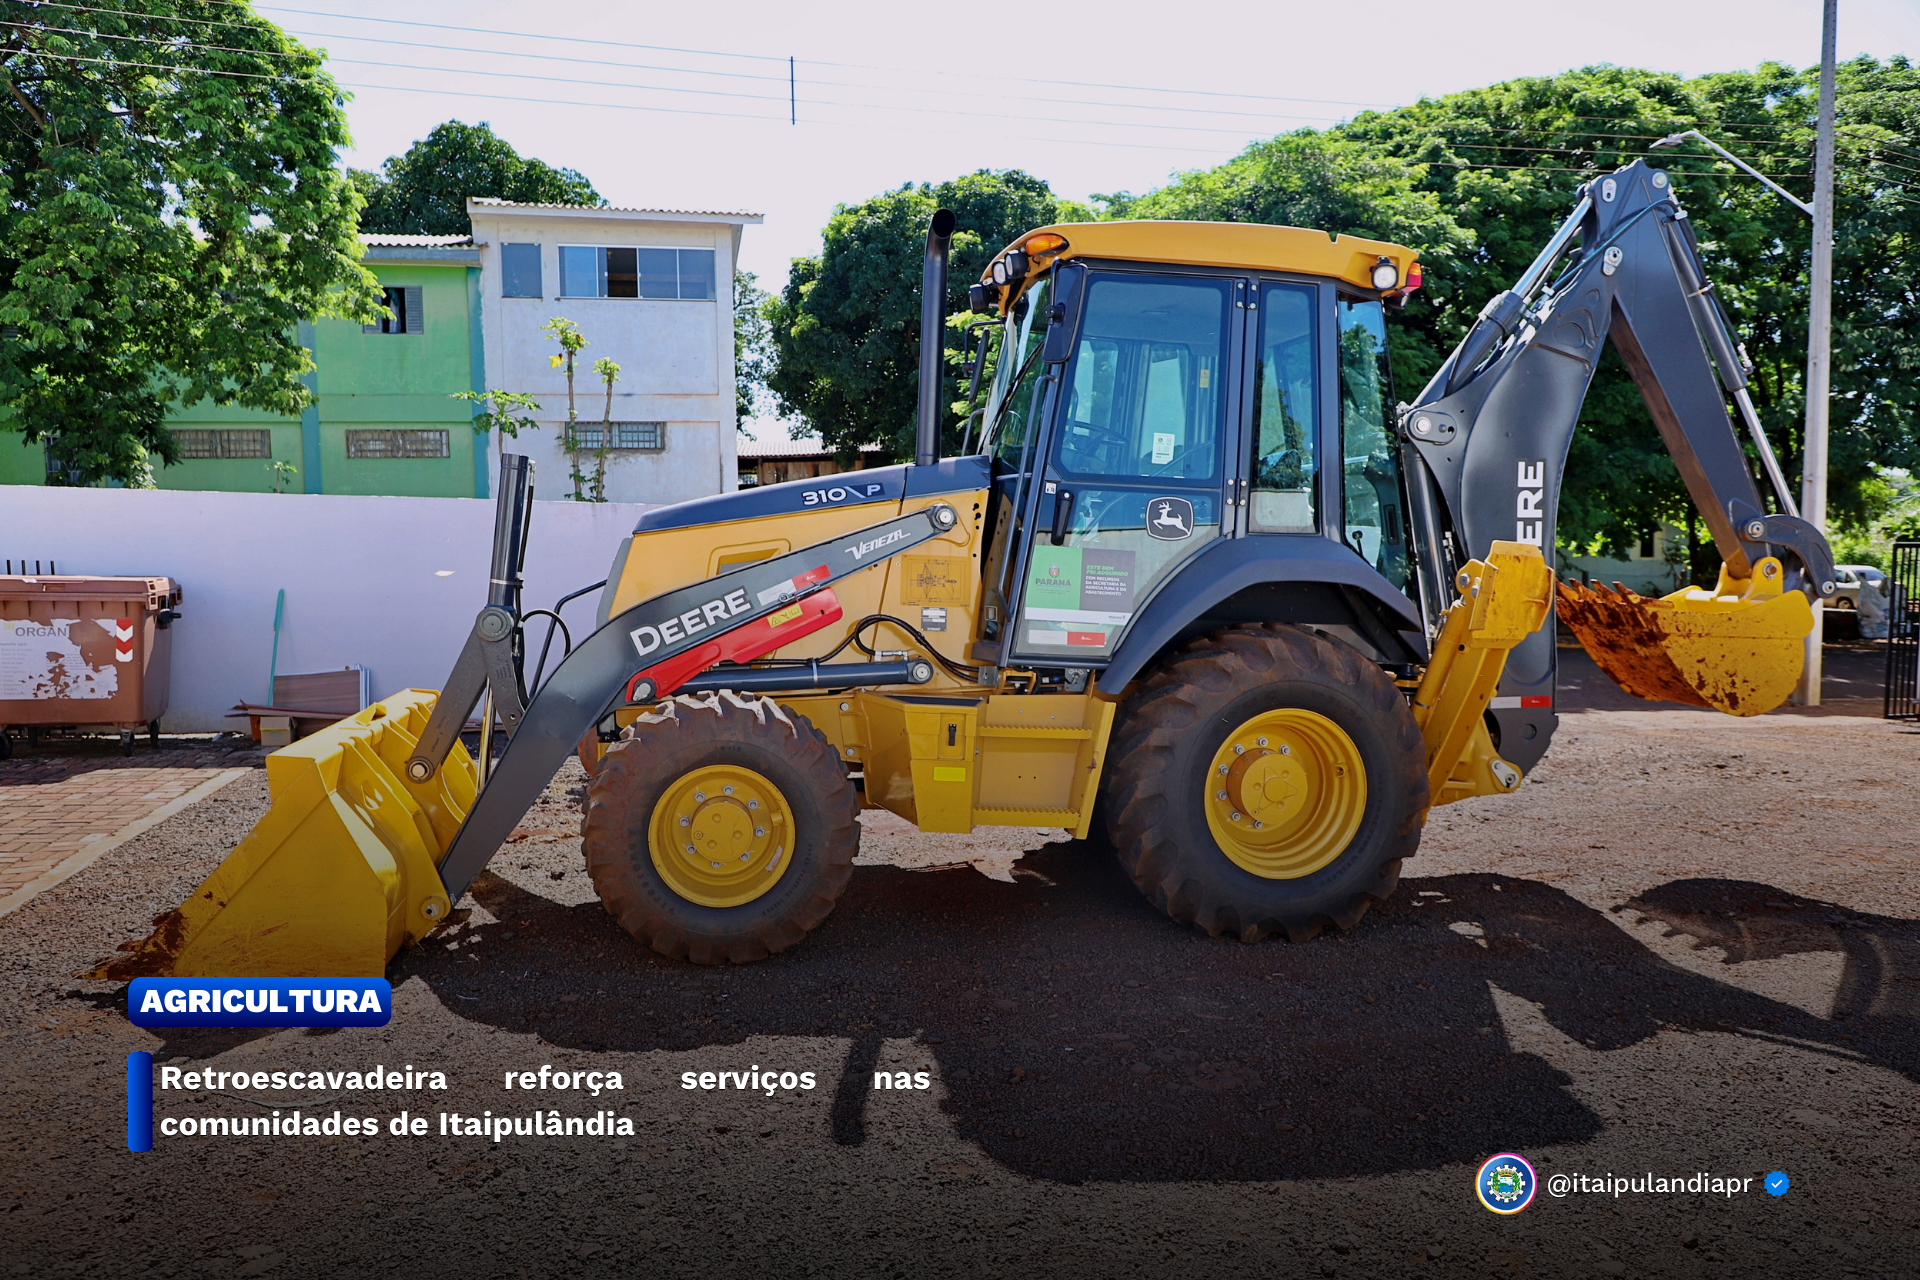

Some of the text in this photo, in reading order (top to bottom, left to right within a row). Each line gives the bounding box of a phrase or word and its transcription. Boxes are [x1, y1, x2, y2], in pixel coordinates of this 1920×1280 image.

[802, 488, 847, 506] 310
[1517, 461, 1544, 554] ERE
[1035, 578, 1072, 587] PARANÁ
[629, 588, 752, 657] DEERE
[15, 627, 67, 637] ORGAN
